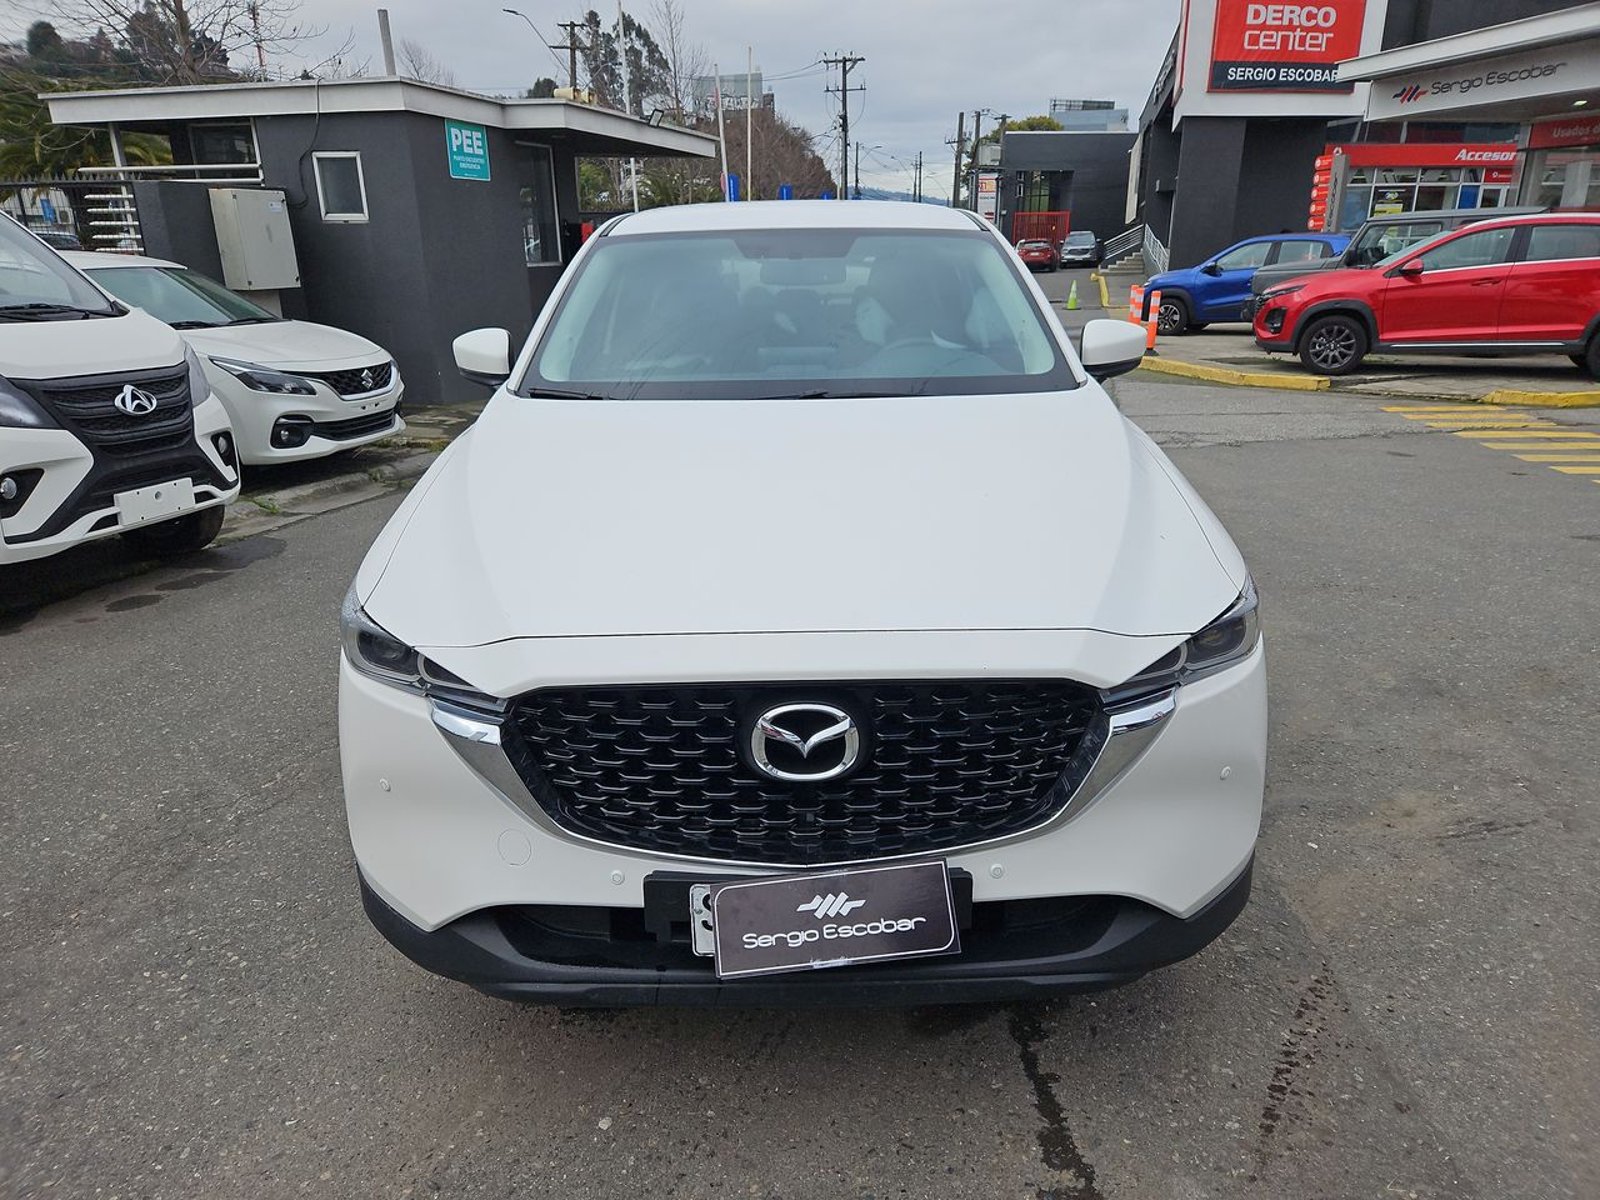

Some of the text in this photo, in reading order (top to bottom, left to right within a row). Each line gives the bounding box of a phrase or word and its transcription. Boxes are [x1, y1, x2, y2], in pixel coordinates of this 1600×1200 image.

[1246, 4, 1336, 27] DERCO
[1243, 28, 1334, 51] center
[1227, 67, 1277, 81] SERGIO
[1485, 62, 1567, 85] Escobar
[450, 127, 484, 155] PEE
[742, 917, 927, 949] Sergio Escobar
